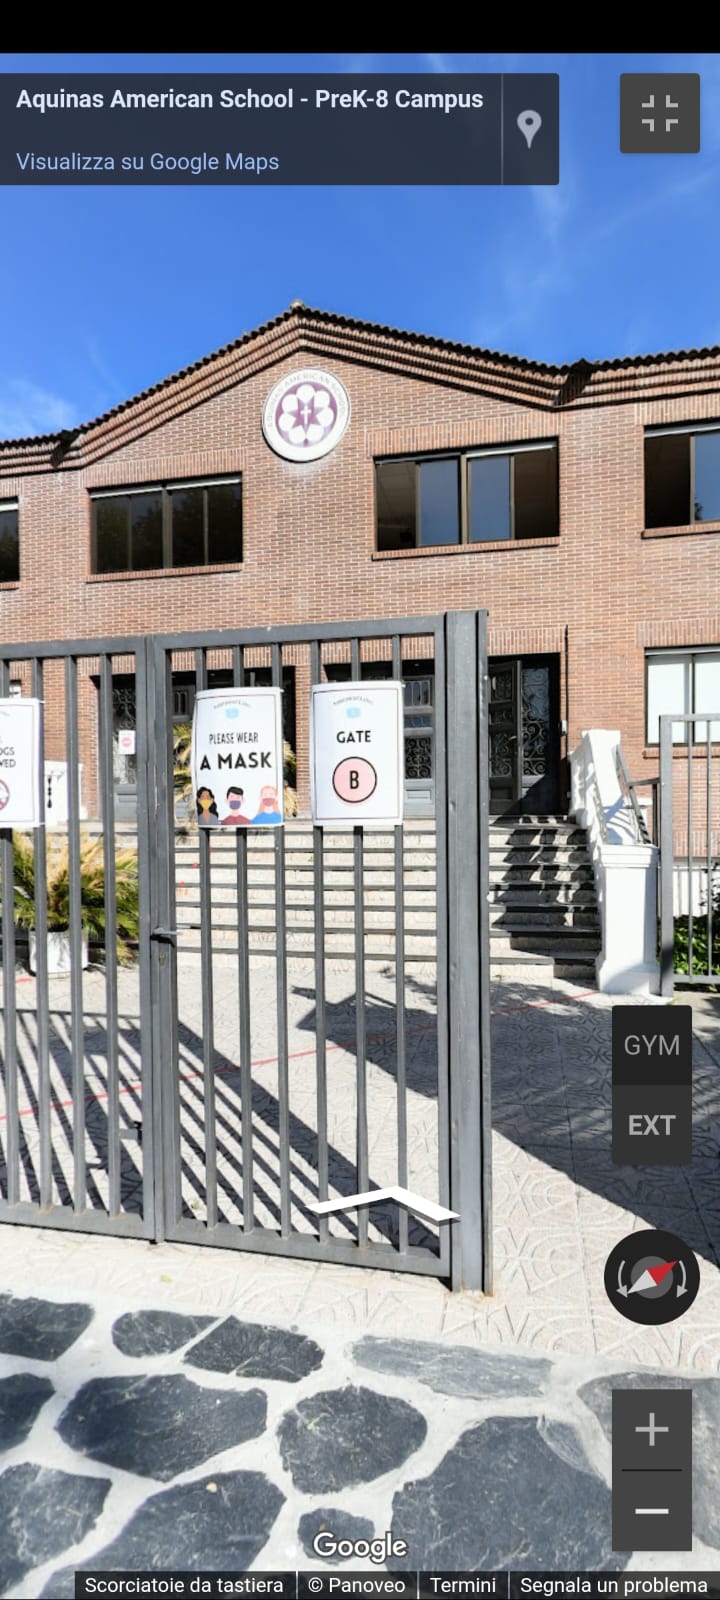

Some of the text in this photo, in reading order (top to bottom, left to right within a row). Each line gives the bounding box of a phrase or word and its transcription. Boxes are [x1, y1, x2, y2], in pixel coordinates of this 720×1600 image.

[209, 731, 259, 745] PLEASE WEAR
[336, 730, 372, 744] GATE
[200, 751, 272, 771] A MASK
[349, 770, 359, 790] B
